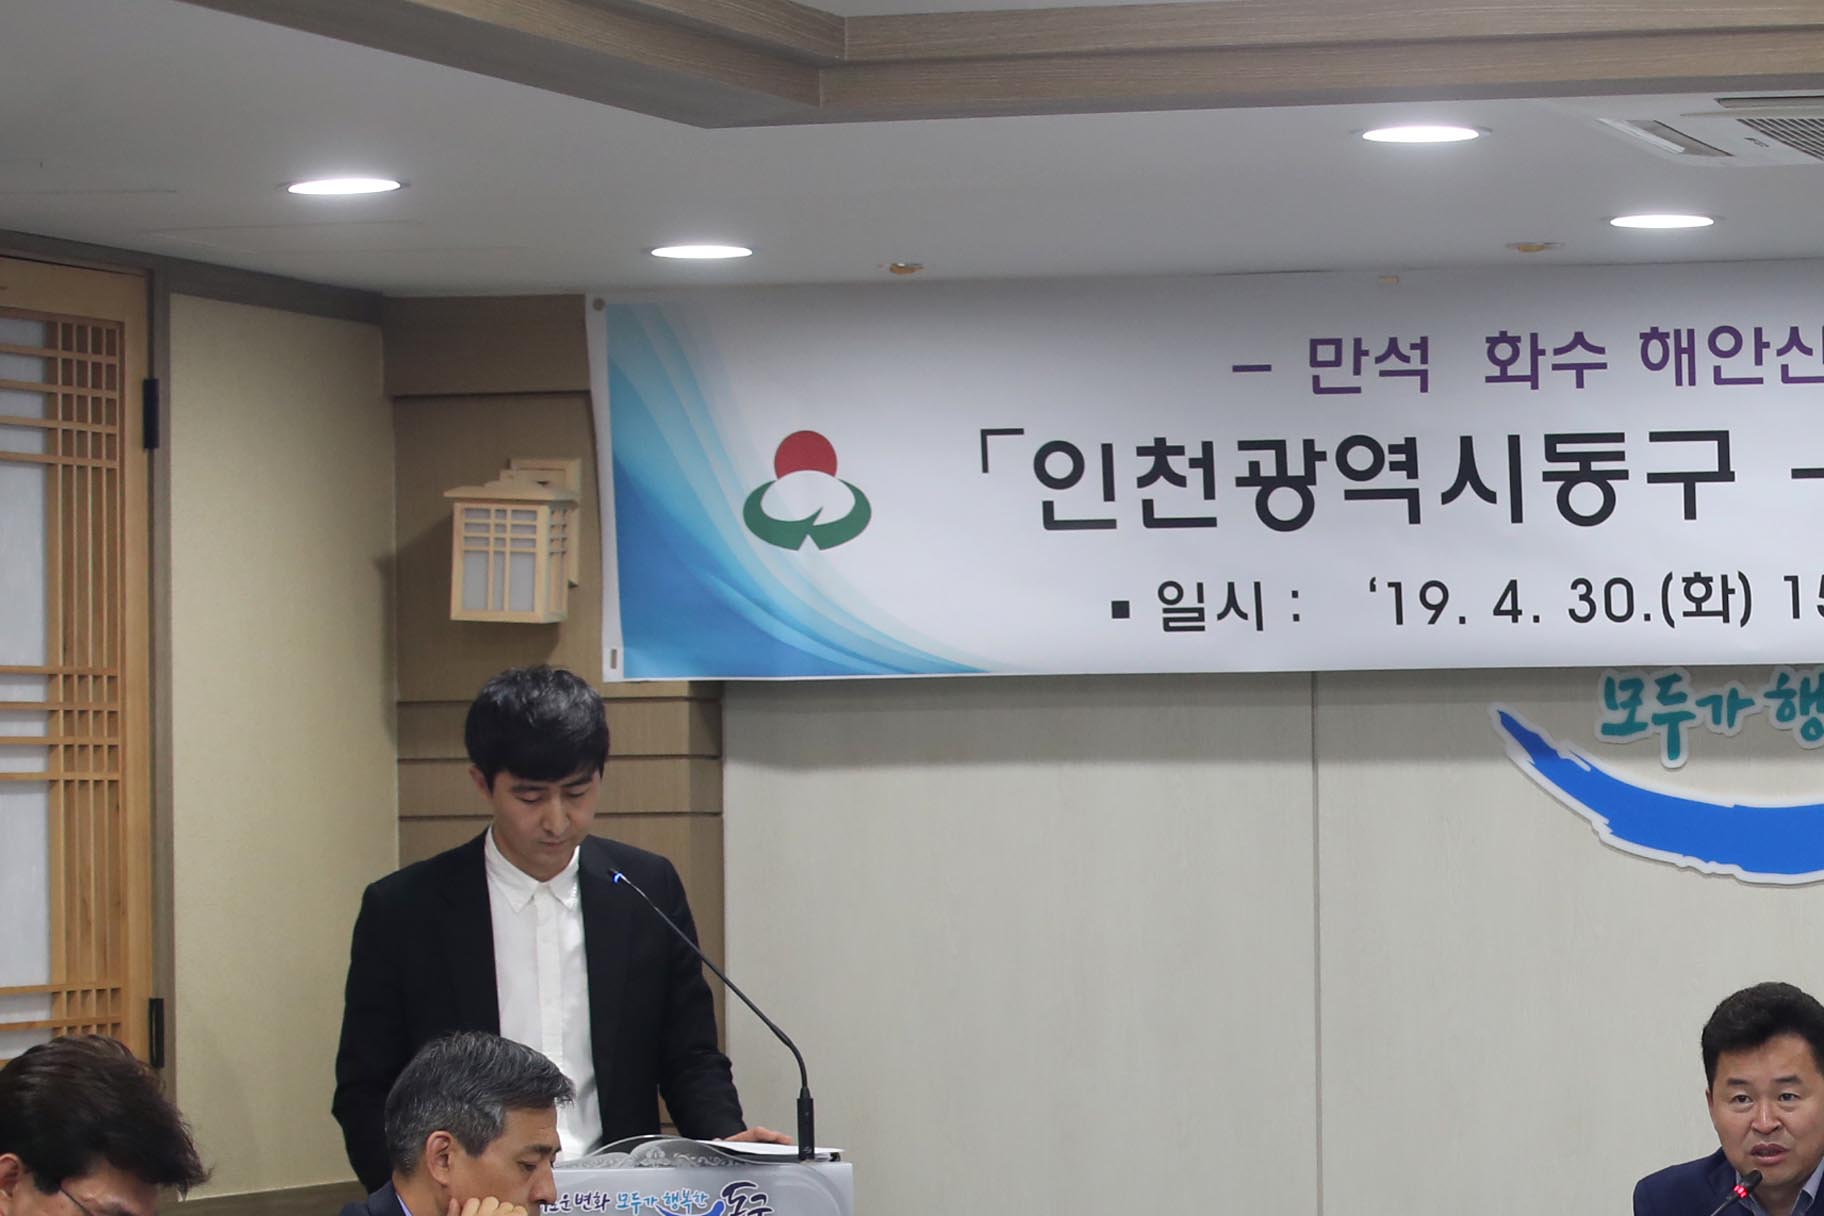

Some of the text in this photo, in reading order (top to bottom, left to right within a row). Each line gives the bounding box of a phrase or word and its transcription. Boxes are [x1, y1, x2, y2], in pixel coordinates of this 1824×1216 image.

[1308, 336, 1430, 396] 만석
[1484, 330, 1609, 391] 화수
[1156, 579, 1264, 633] 일시
[1602, 674, 1753, 760] 모두가
[575, 1192, 611, 1212] 변화
[616, 1191, 657, 1215] 모두가
[663, 1189, 708, 1213] 행복한
